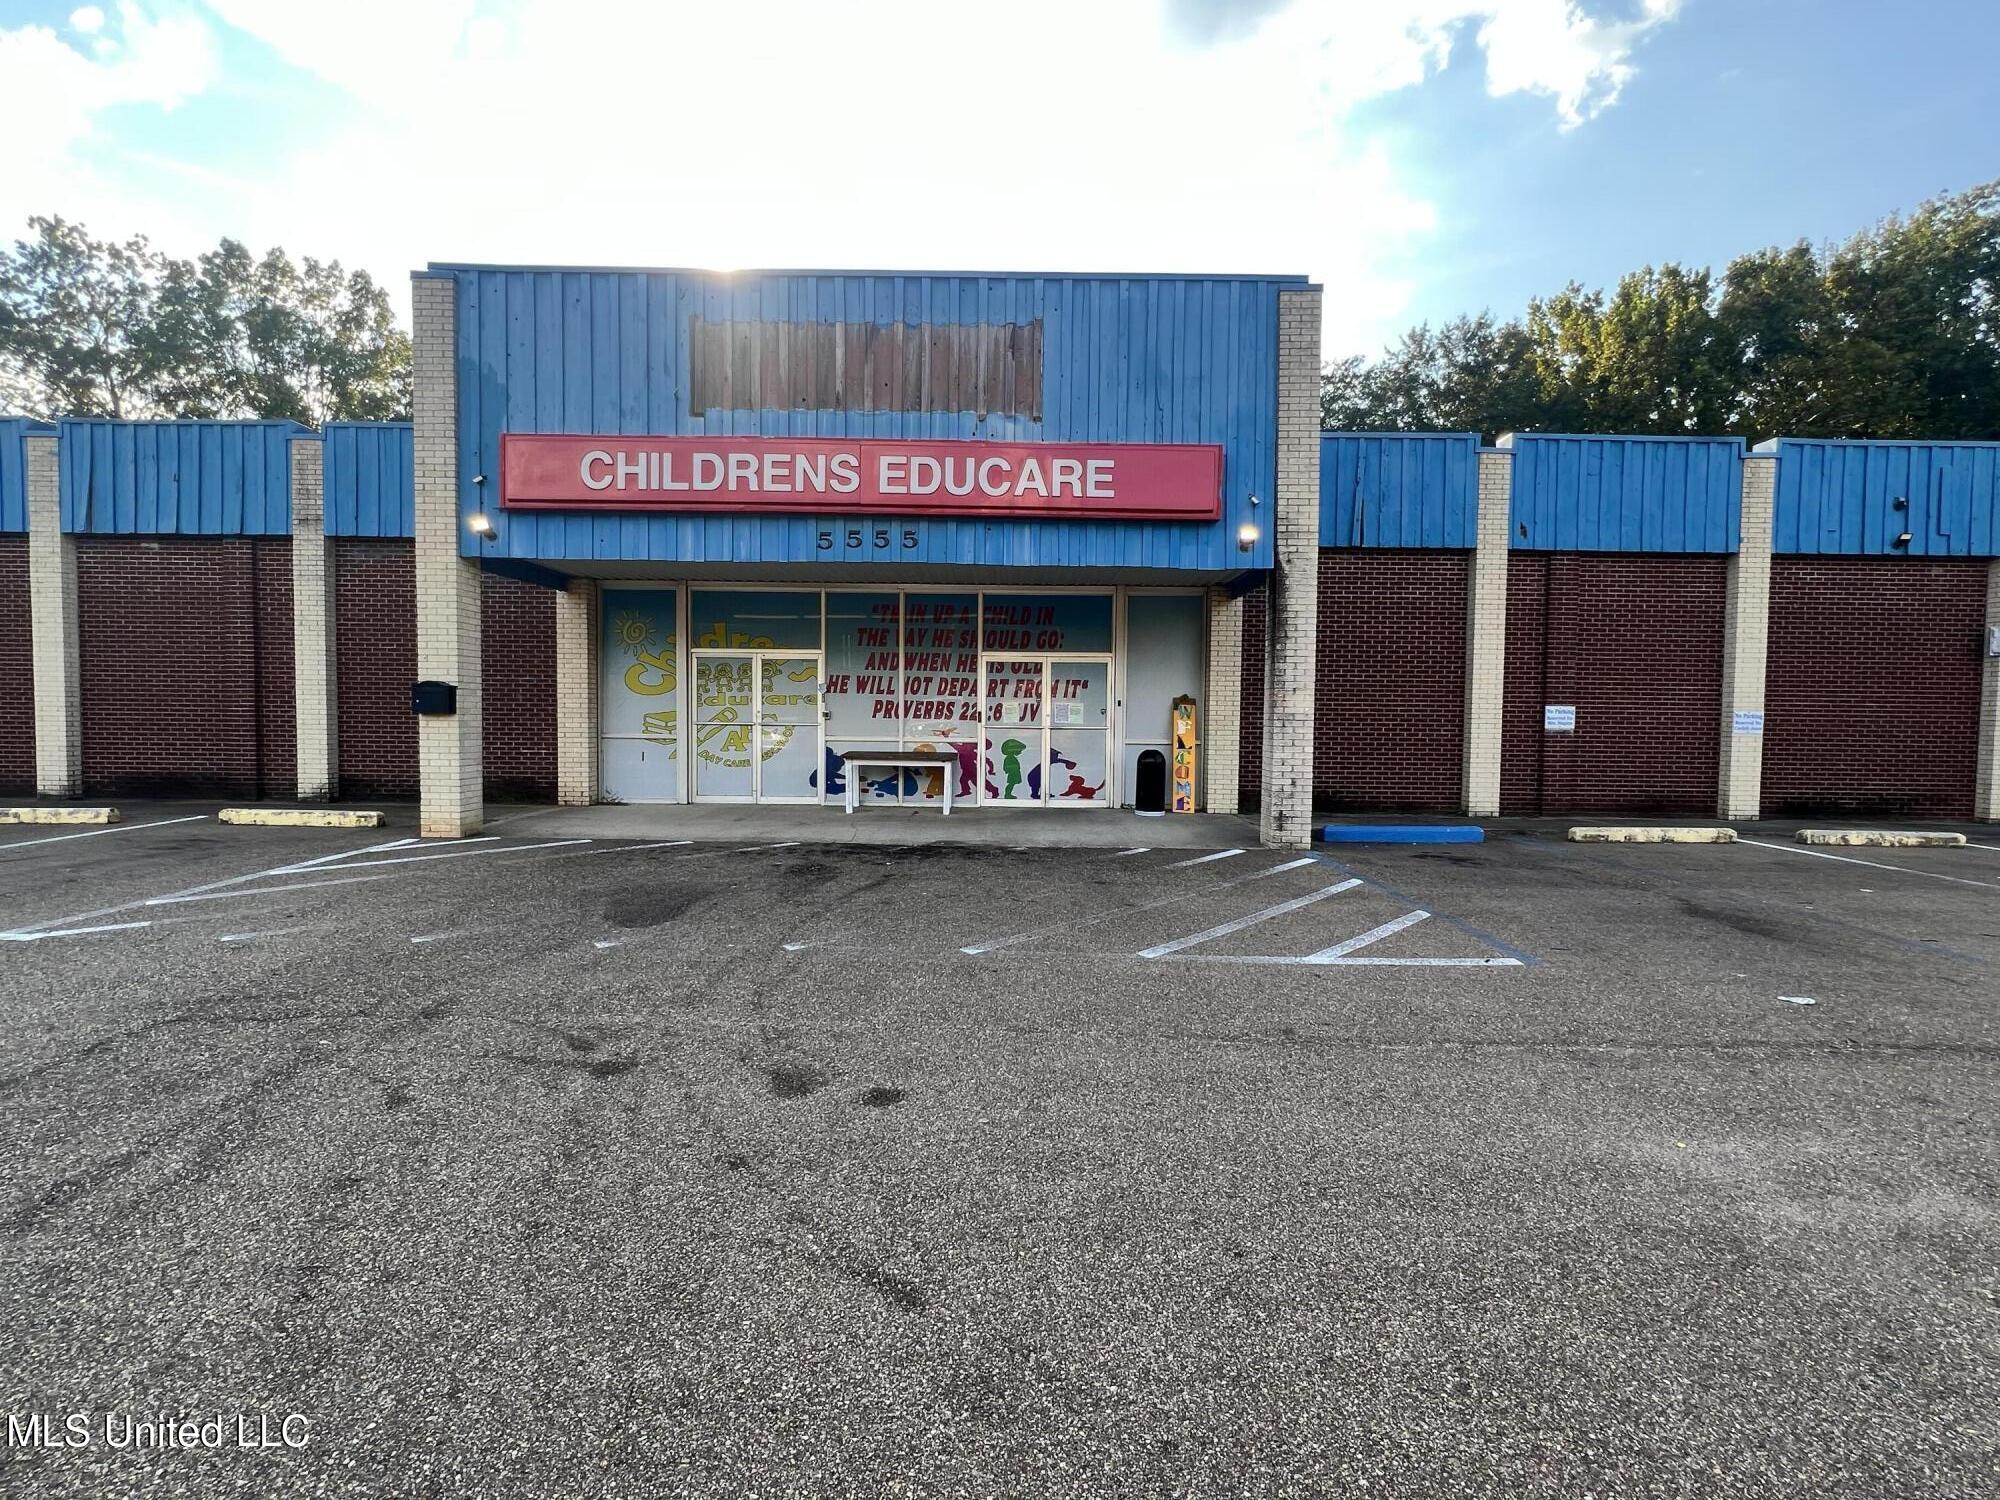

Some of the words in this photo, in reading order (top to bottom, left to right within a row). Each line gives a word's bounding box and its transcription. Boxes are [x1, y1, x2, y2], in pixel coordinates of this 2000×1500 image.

[580, 450, 860, 493] CHILDRENS
[879, 455, 1115, 498] EDUCARE
[816, 530, 919, 551] 5555
[933, 604, 955, 624] UP
[1036, 606, 1056, 625] IN
[857, 628, 890, 647] THE
[932, 629, 955, 648] HE
[958, 629, 1031, 649] SHOULD
[1036, 630, 1065, 649] GO:
[865, 652, 899, 671] AND
[904, 652, 952, 671] WHEN
[956, 654, 978, 673] HE
[826, 675, 850, 693] HE
[856, 675, 895, 695] WILL
[937, 677, 1009, 698] DEPART
[1174, 705, 1193, 812] WELCOME
